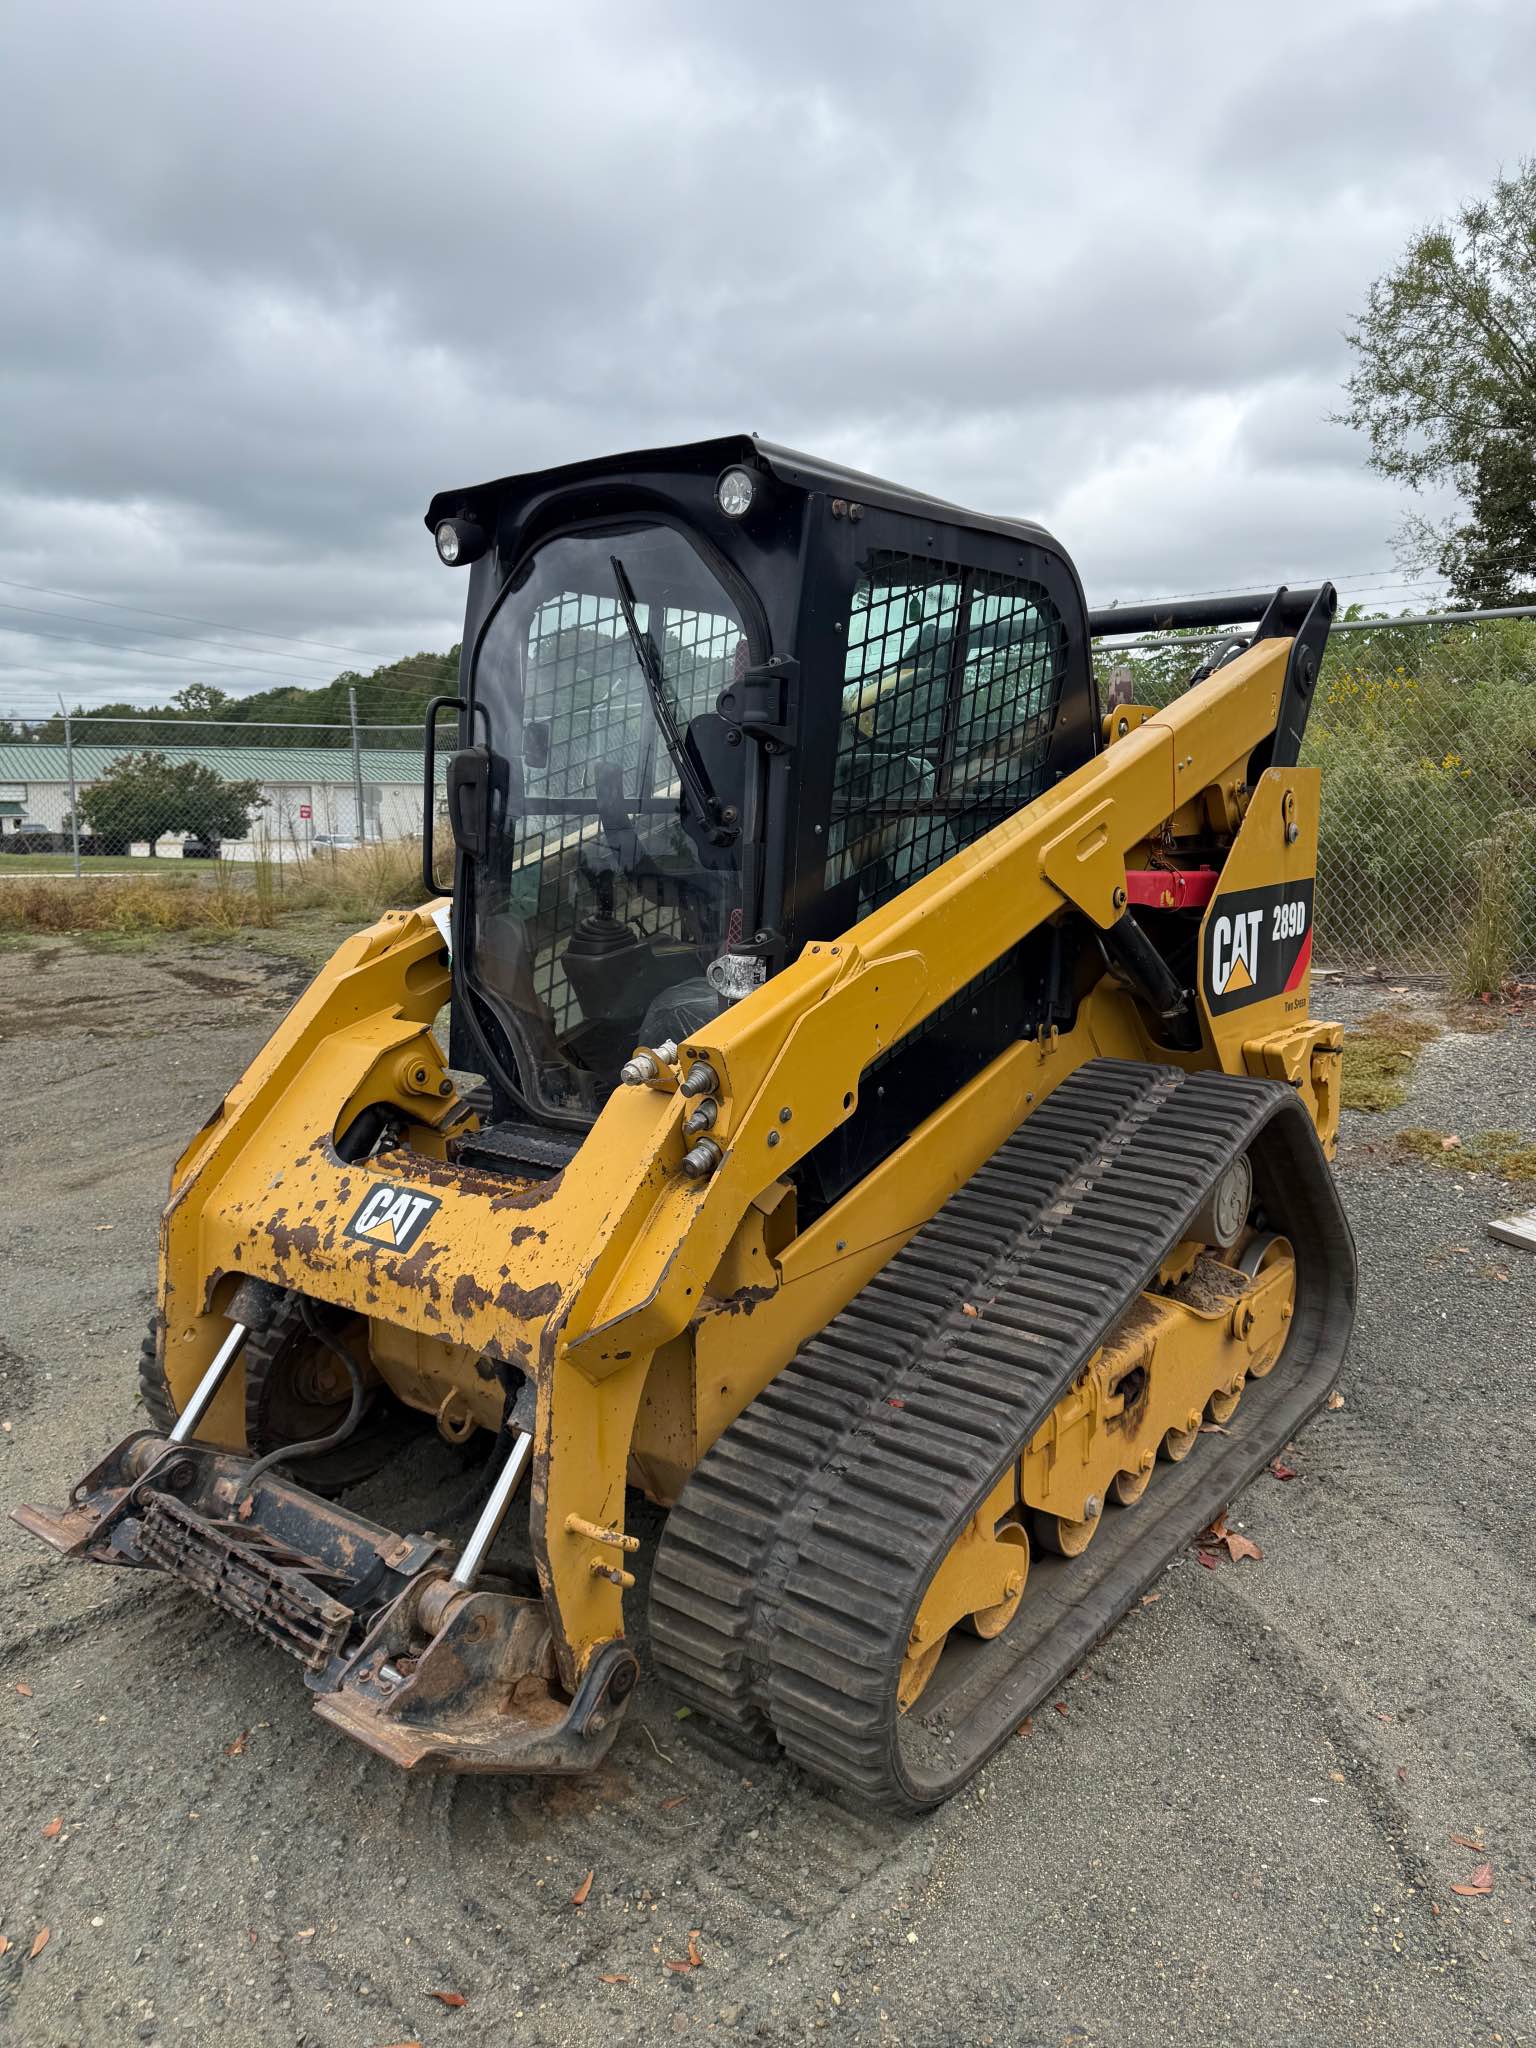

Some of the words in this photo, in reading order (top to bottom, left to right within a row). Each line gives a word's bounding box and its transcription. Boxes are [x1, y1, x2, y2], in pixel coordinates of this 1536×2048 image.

[1212, 909, 1263, 996] CAT
[1272, 901, 1306, 941] 289D
[355, 1188, 433, 1246] CAT
